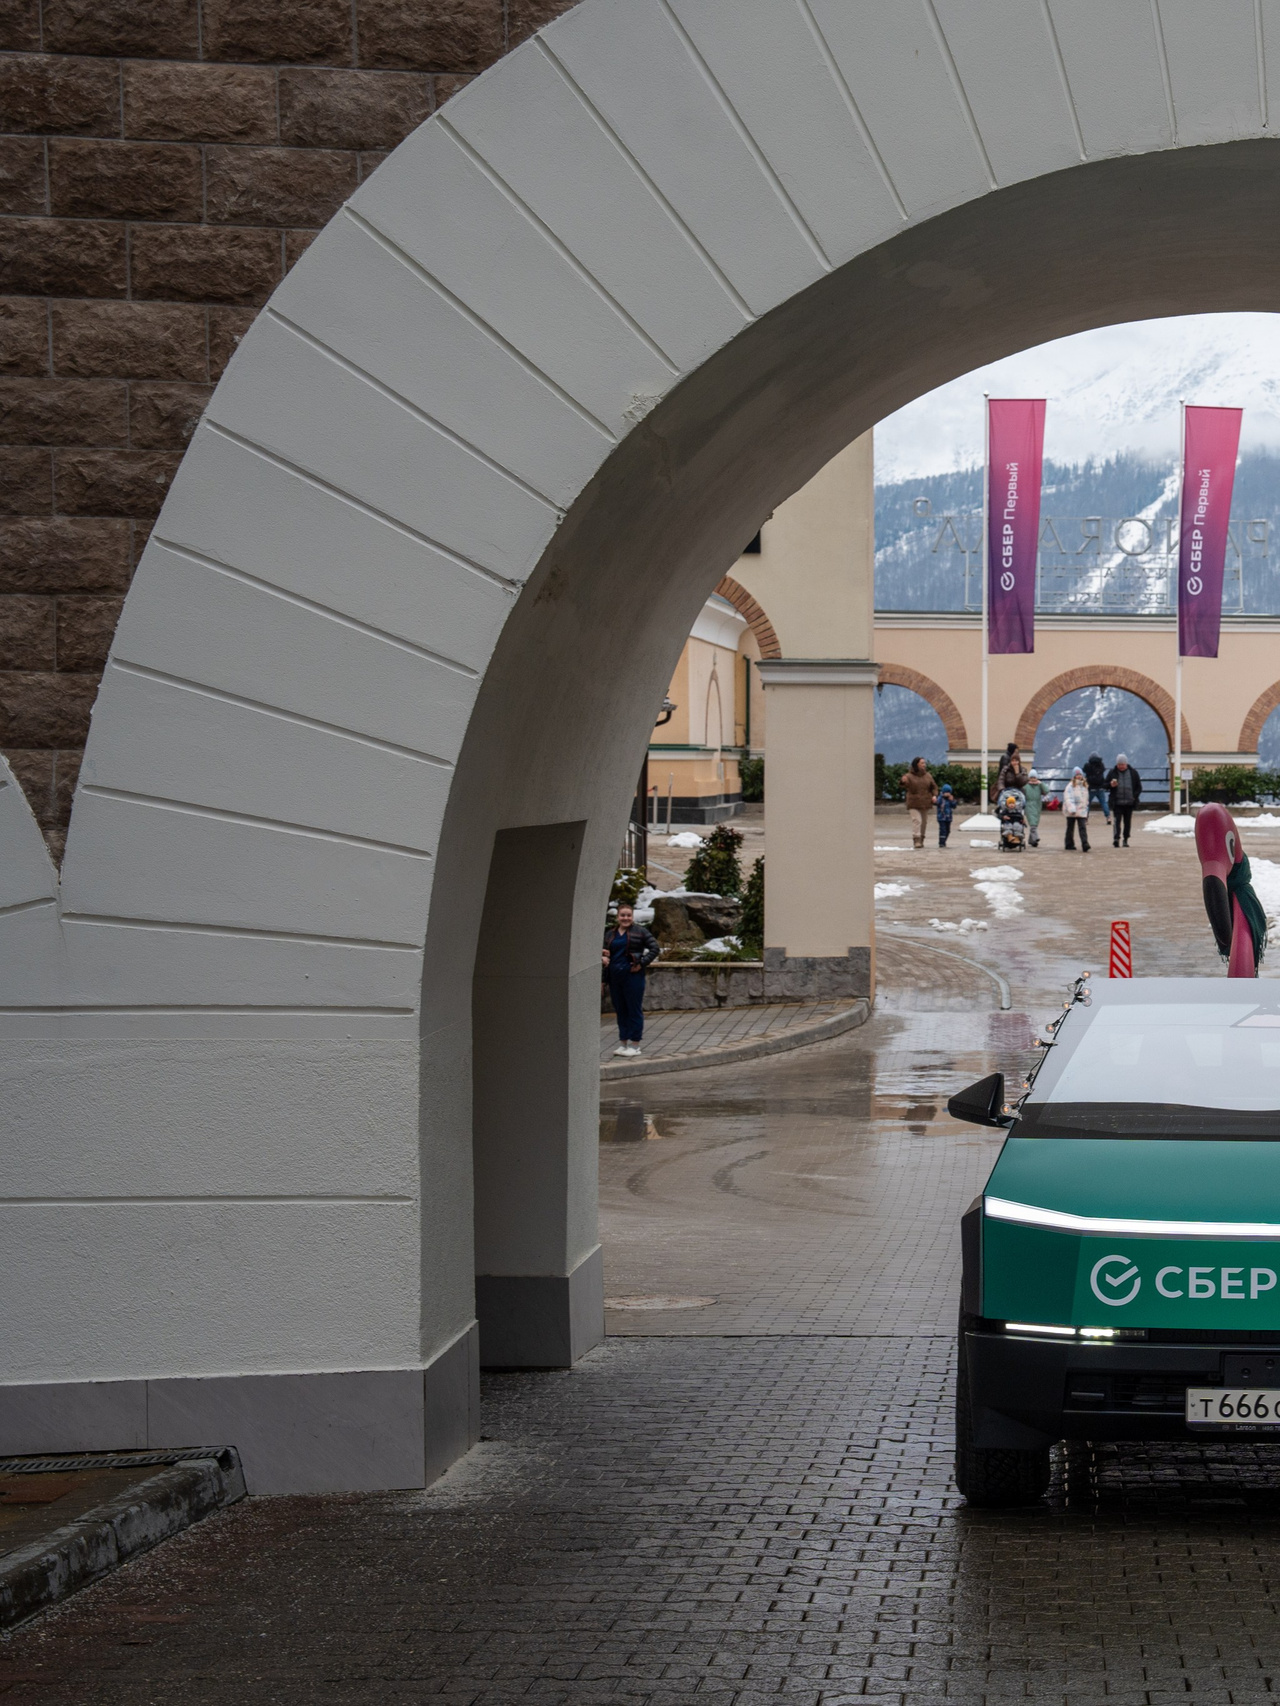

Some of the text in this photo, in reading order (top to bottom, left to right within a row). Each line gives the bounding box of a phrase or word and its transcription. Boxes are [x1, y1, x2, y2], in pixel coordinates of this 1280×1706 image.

[1001, 462, 1018, 568] СБЕР Первый
[1190, 469, 1211, 573] СБЕР Первый
[1155, 1266, 1278, 1300] СБЕР
